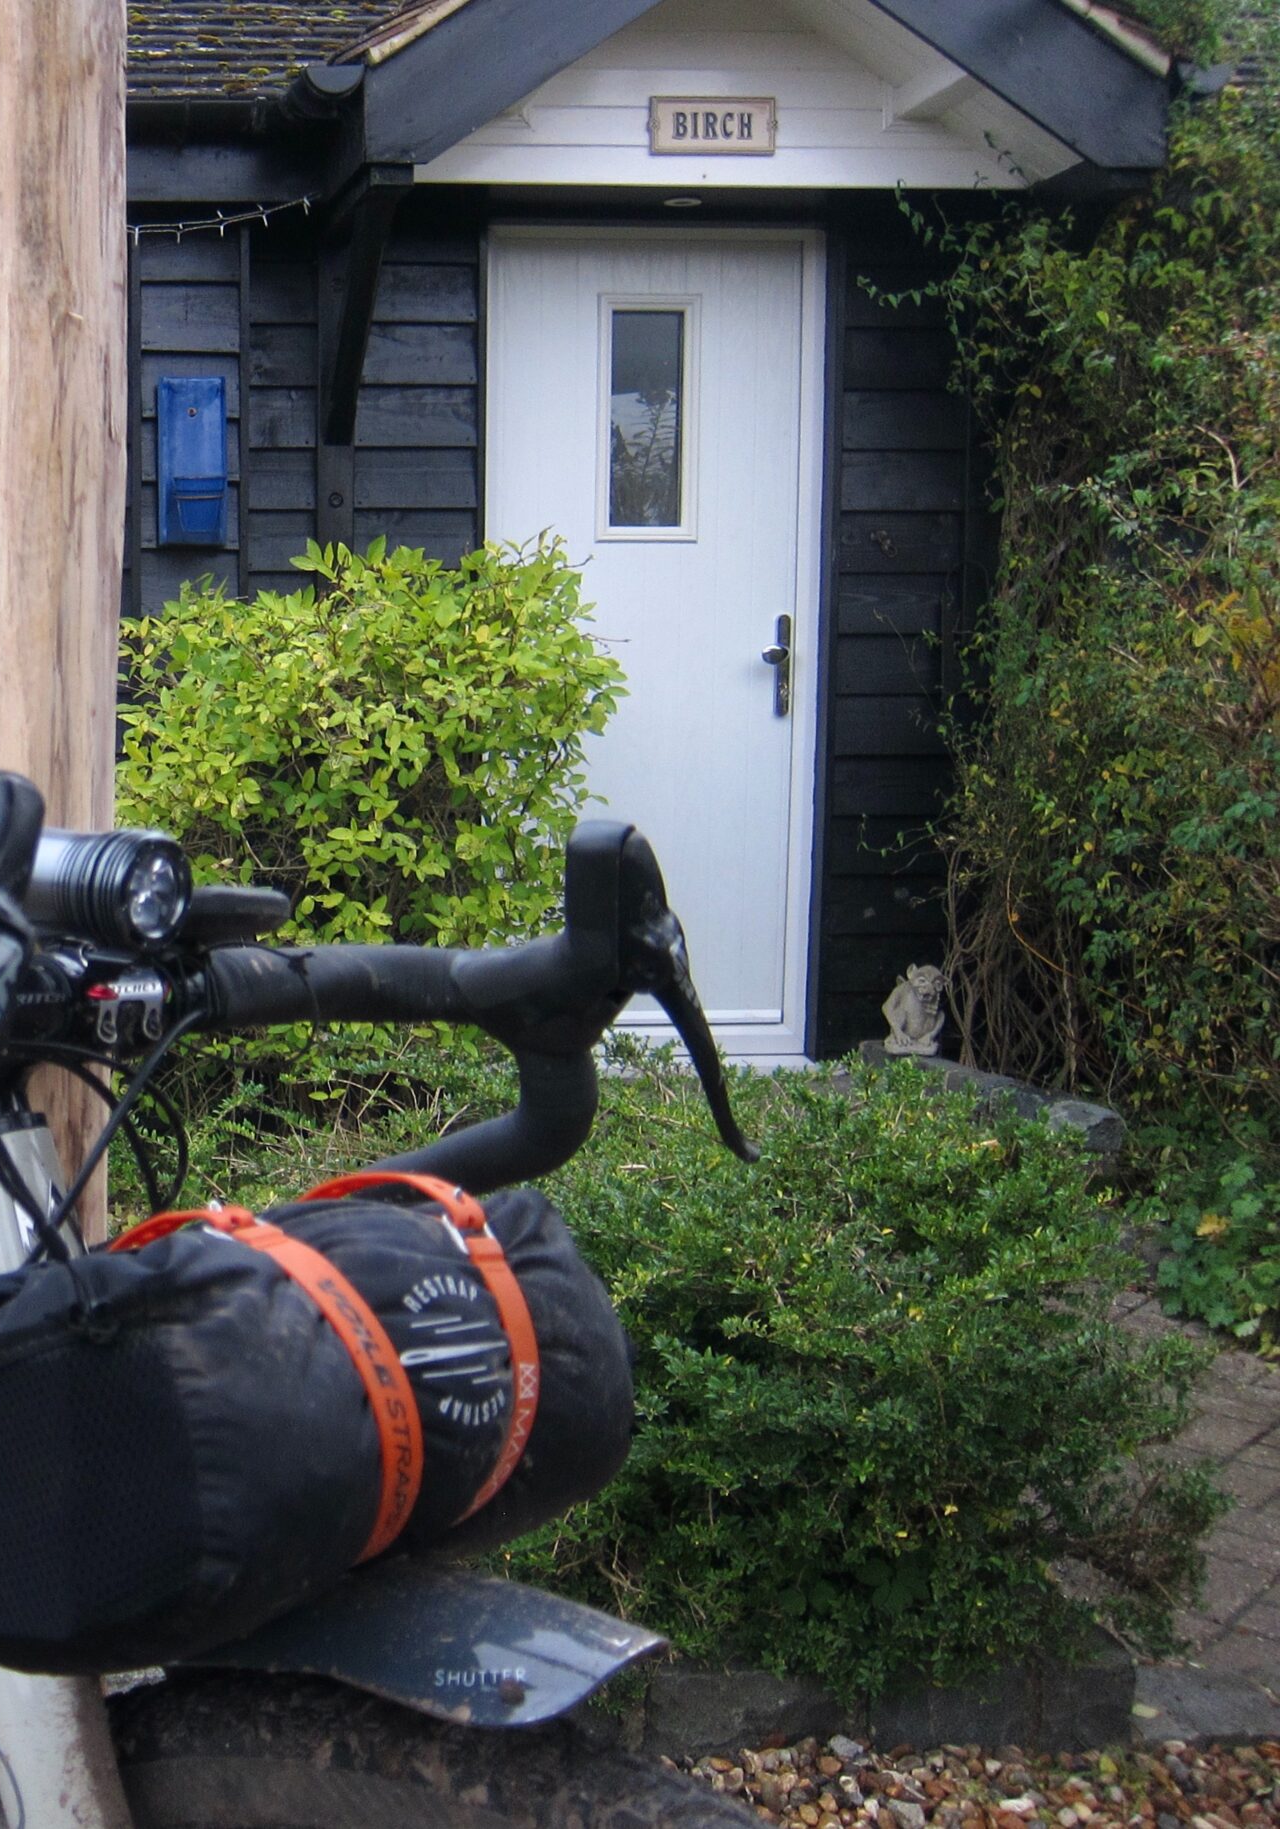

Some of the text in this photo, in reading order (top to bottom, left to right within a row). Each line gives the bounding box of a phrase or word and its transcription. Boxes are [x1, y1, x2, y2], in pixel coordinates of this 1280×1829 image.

[672, 112, 752, 140] BIRCH
[403, 1275, 478, 1313] RESTRAP
[438, 1388, 506, 1427] RESTRAP
[434, 1667, 526, 1688] SHUTTER
